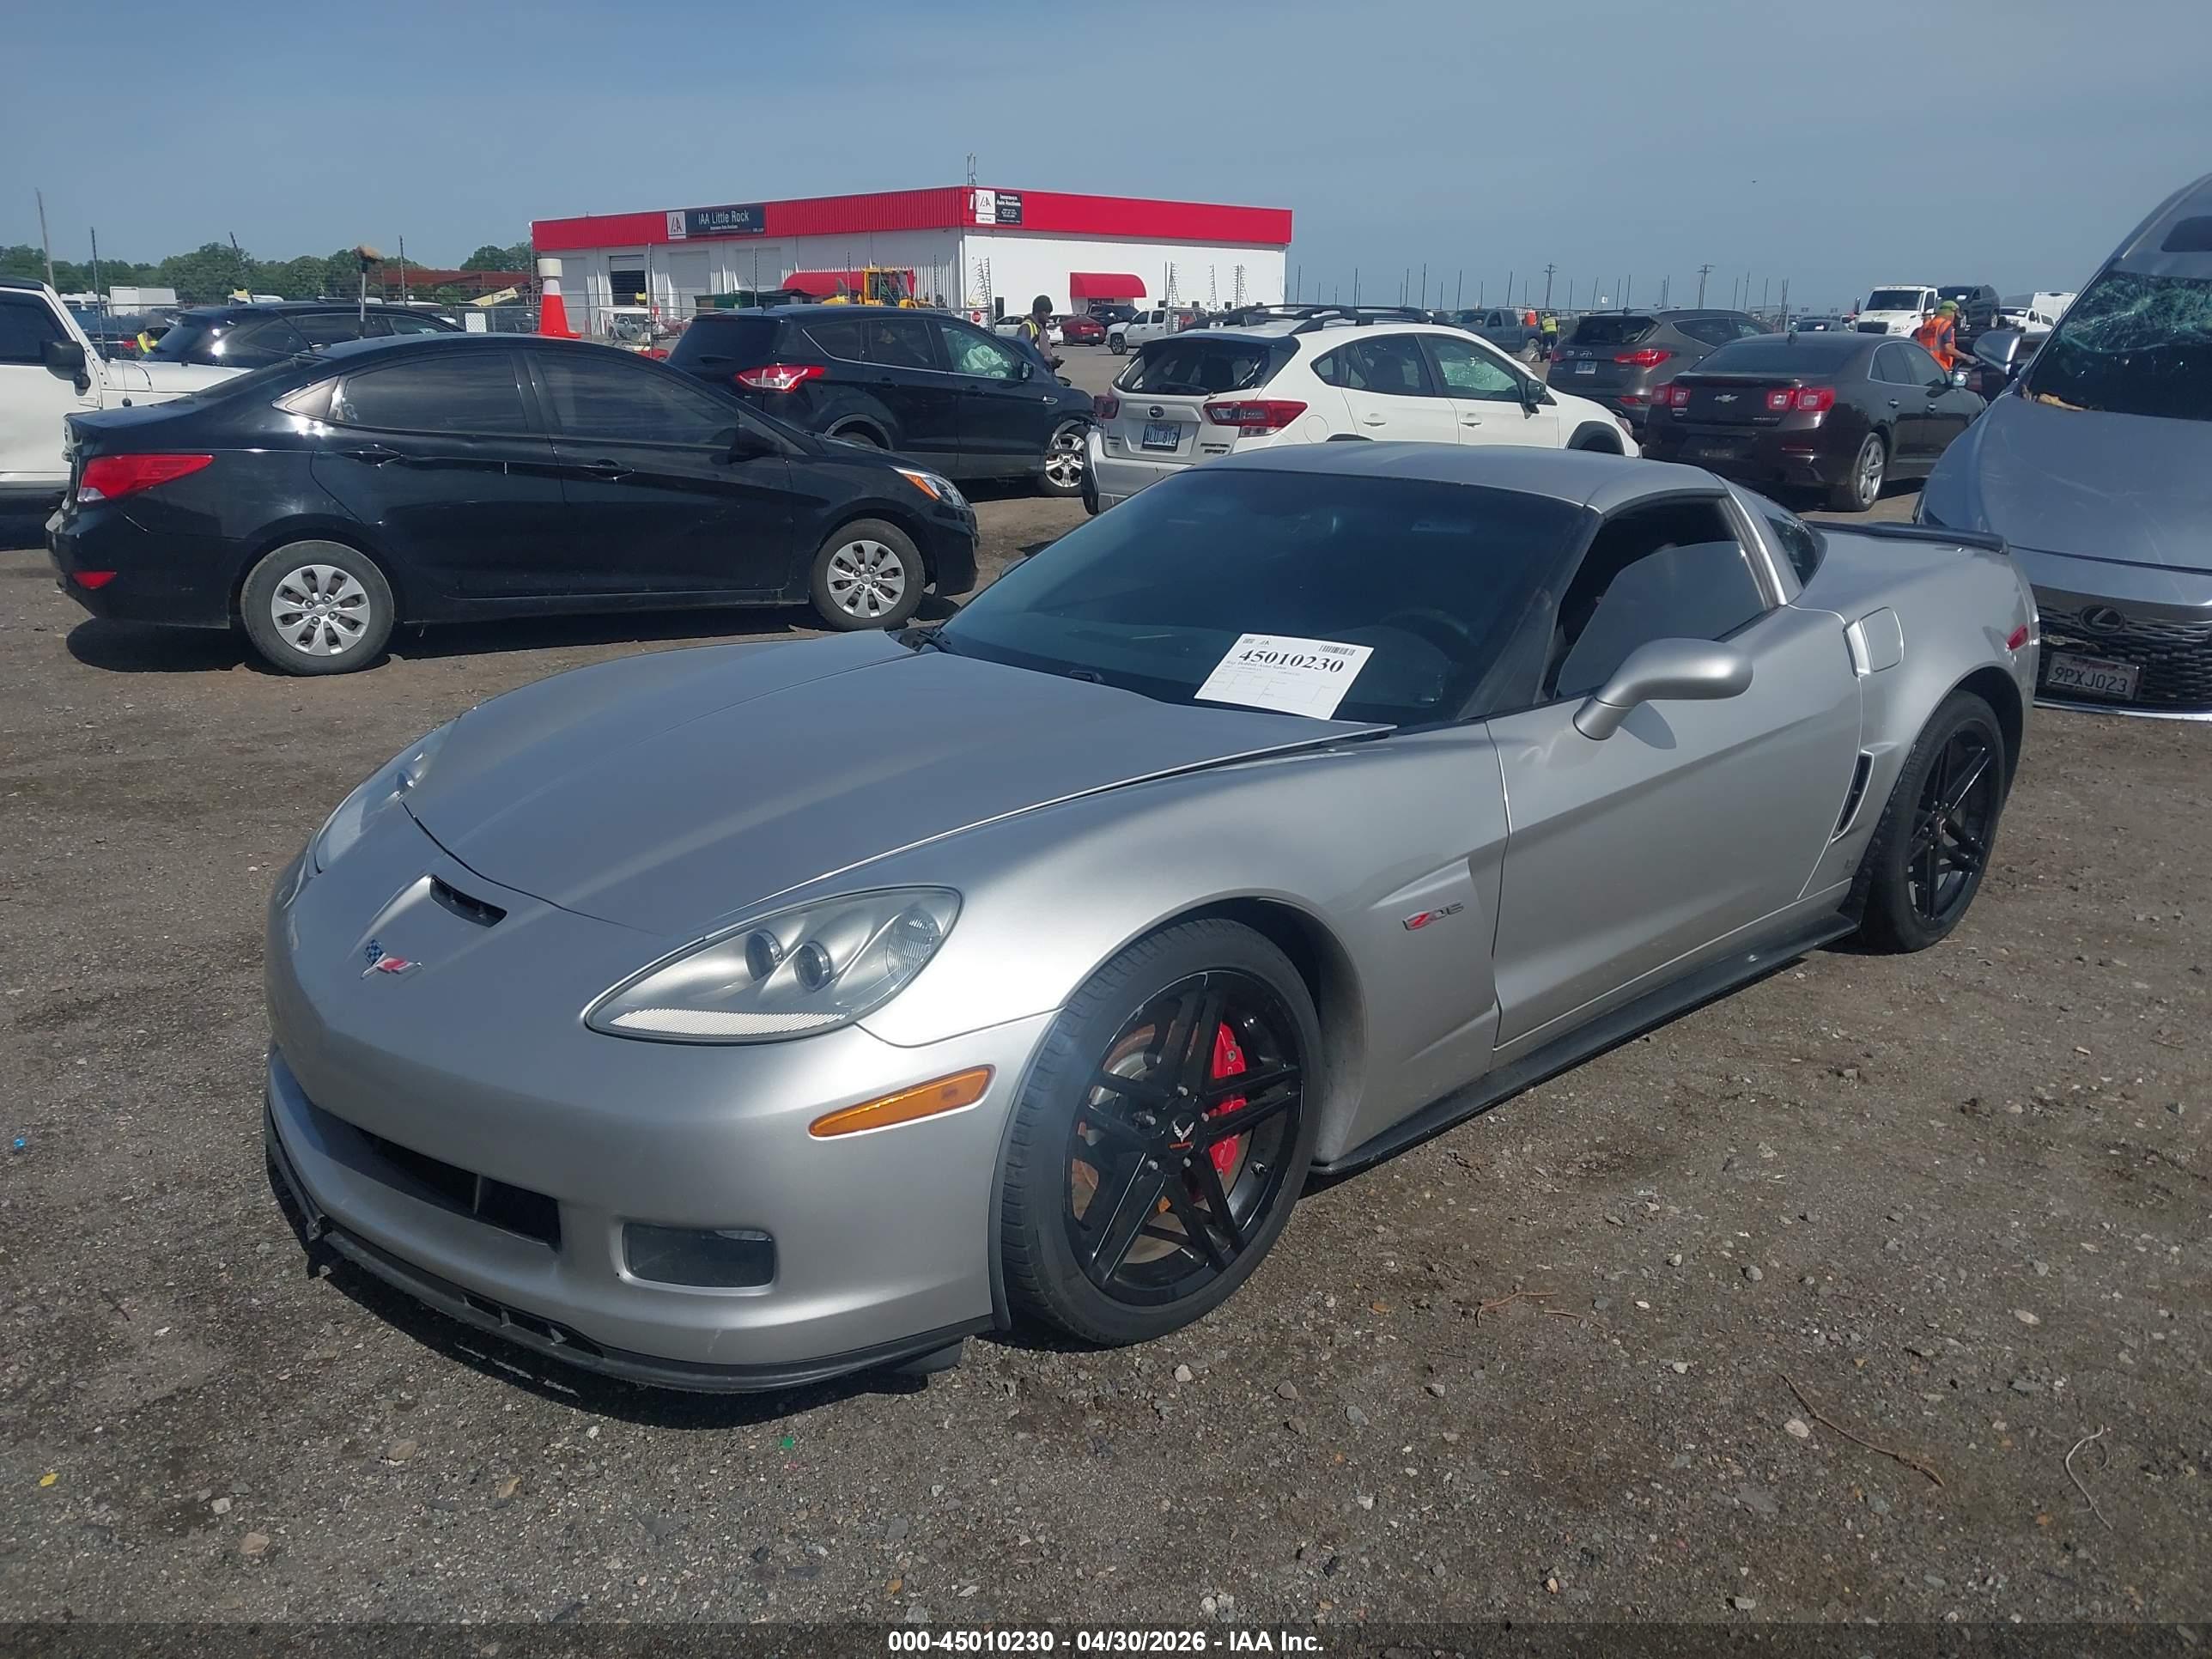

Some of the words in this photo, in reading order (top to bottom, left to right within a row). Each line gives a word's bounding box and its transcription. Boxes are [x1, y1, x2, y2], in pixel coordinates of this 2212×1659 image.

[698, 212, 710, 225] IAA
[711, 211, 729, 224] Little
[731, 210, 750, 222] Rock
[1238, 649, 1345, 673] 45010230
[2053, 666, 2128, 693] 9PXJ023
